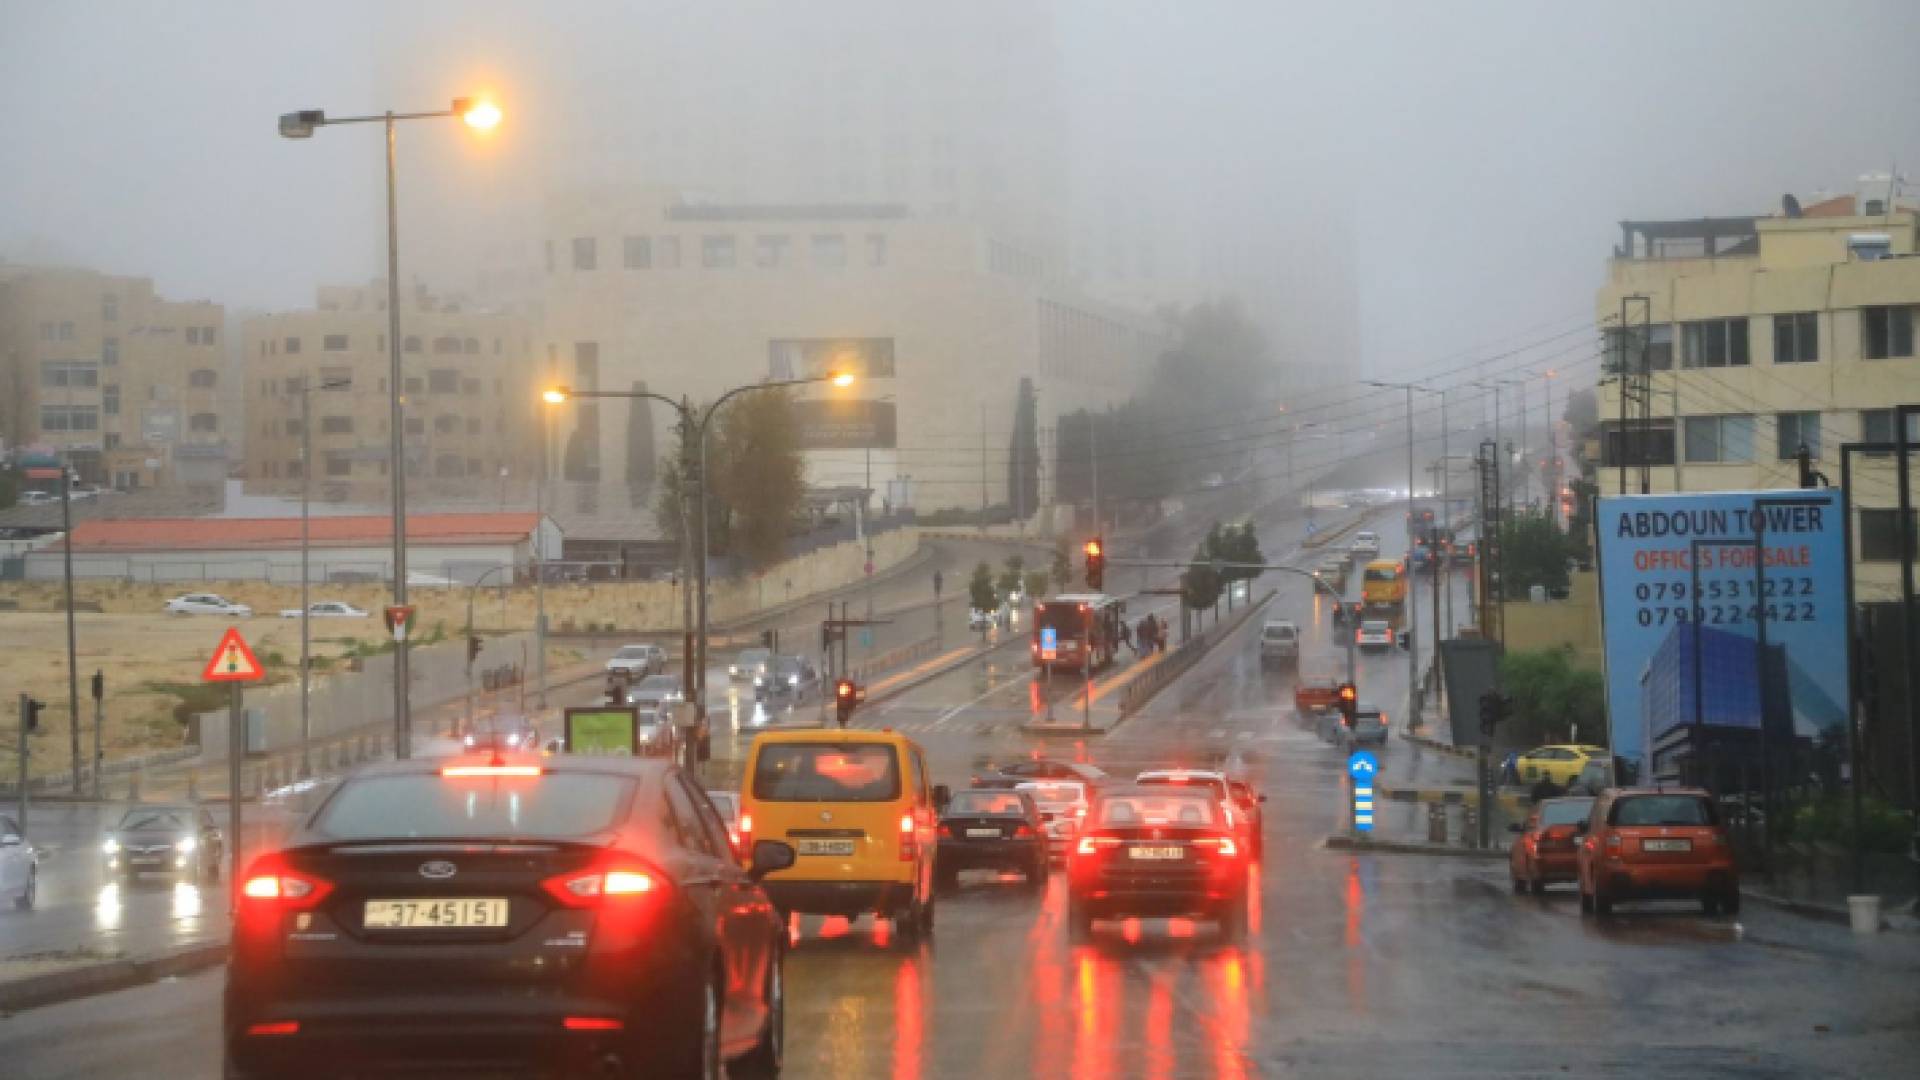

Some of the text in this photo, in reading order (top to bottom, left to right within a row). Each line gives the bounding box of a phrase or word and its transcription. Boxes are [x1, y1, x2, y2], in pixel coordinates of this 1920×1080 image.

[1617, 506, 1824, 538] ABDOUN TOWER
[1719, 547, 1756, 568] FOR
[1762, 545, 1812, 567] SALE
[391, 901, 499, 925] 37-45151
